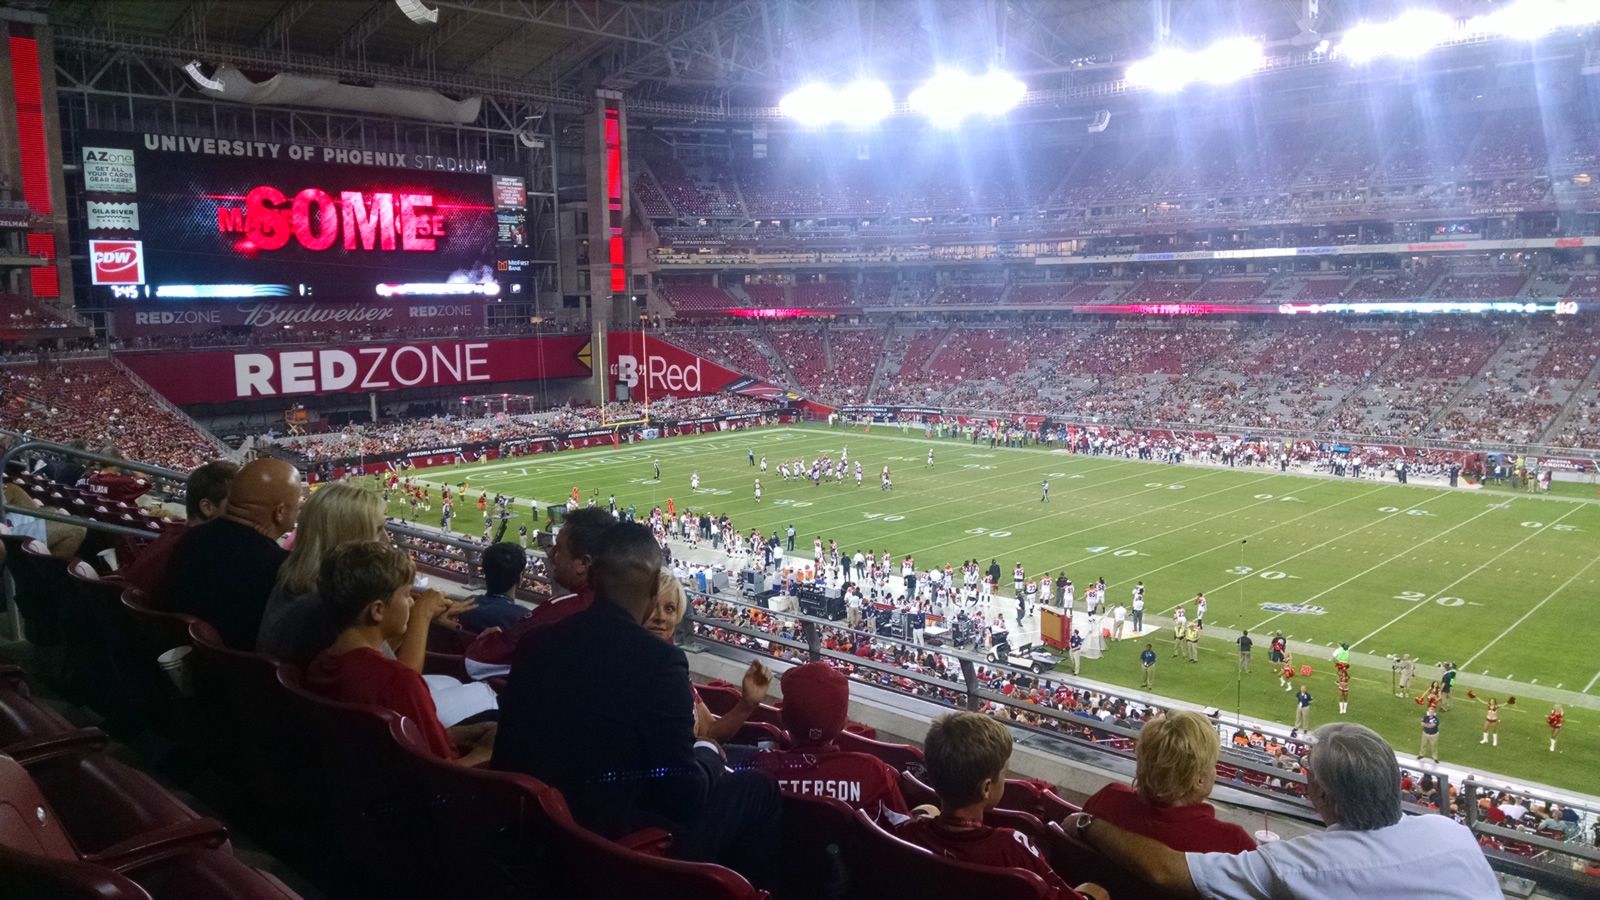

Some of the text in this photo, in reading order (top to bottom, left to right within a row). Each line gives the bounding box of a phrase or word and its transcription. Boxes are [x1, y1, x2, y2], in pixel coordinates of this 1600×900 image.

[144, 133, 487, 173] UNIVERSITY OF PHOENIX STADIUM
[95, 251, 131, 263] CDW
[135, 310, 222, 325] REDZONE
[237, 302, 393, 327] Budweiser
[409, 304, 473, 318] REDZONE
[234, 343, 490, 397] REDZONE
[649, 355, 700, 391] Red
[432, 447, 461, 455] CARDINALS
[1086, 546, 1138, 557] 40
[1225, 565, 1286, 580] 30
[1393, 590, 1465, 607] 20
